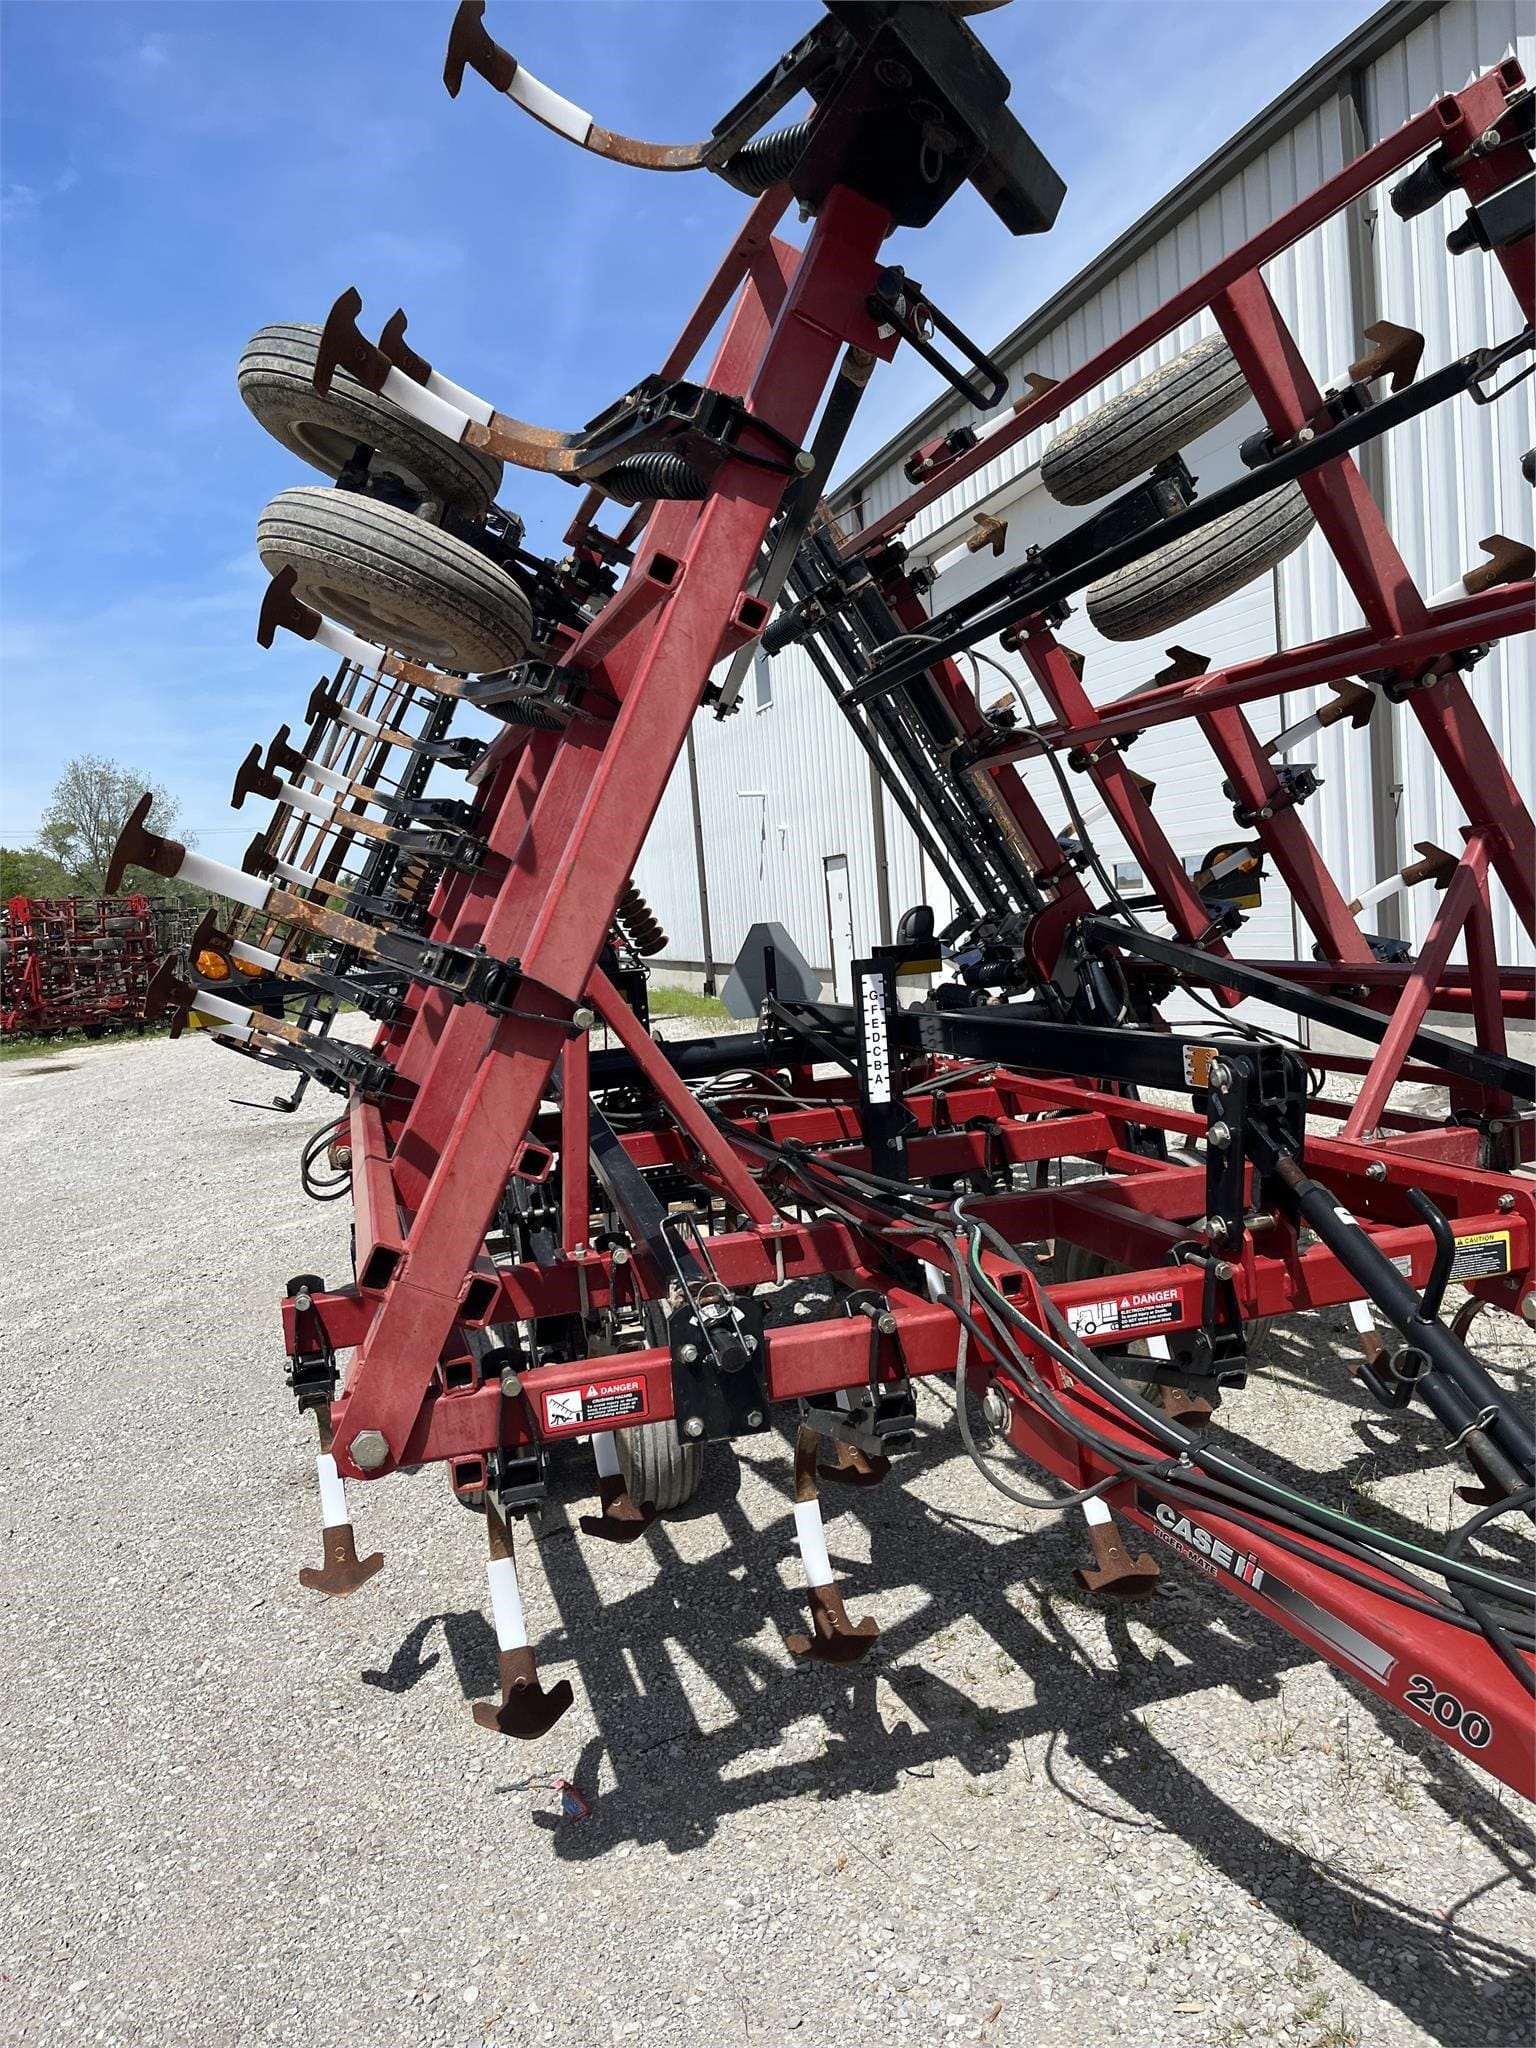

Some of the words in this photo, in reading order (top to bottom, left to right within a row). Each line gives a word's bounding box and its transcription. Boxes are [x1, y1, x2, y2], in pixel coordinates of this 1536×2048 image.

[869, 990, 878, 1000] G
[871, 1005, 878, 1014] F
[872, 1019, 879, 1028] E
[872, 1033, 880, 1042] D
[873, 1046, 881, 1056] C
[874, 1060, 882, 1070] B
[875, 1074, 883, 1084] A
[1464, 1234, 1494, 1244] CAUTION
[1132, 1289, 1178, 1306] DANGER
[600, 1382, 639, 1395] DANGER
[1156, 1503, 1234, 1570] CASE
[1153, 1524, 1218, 1578] TIGER-MATE
[1403, 1674, 1492, 1748] 200
